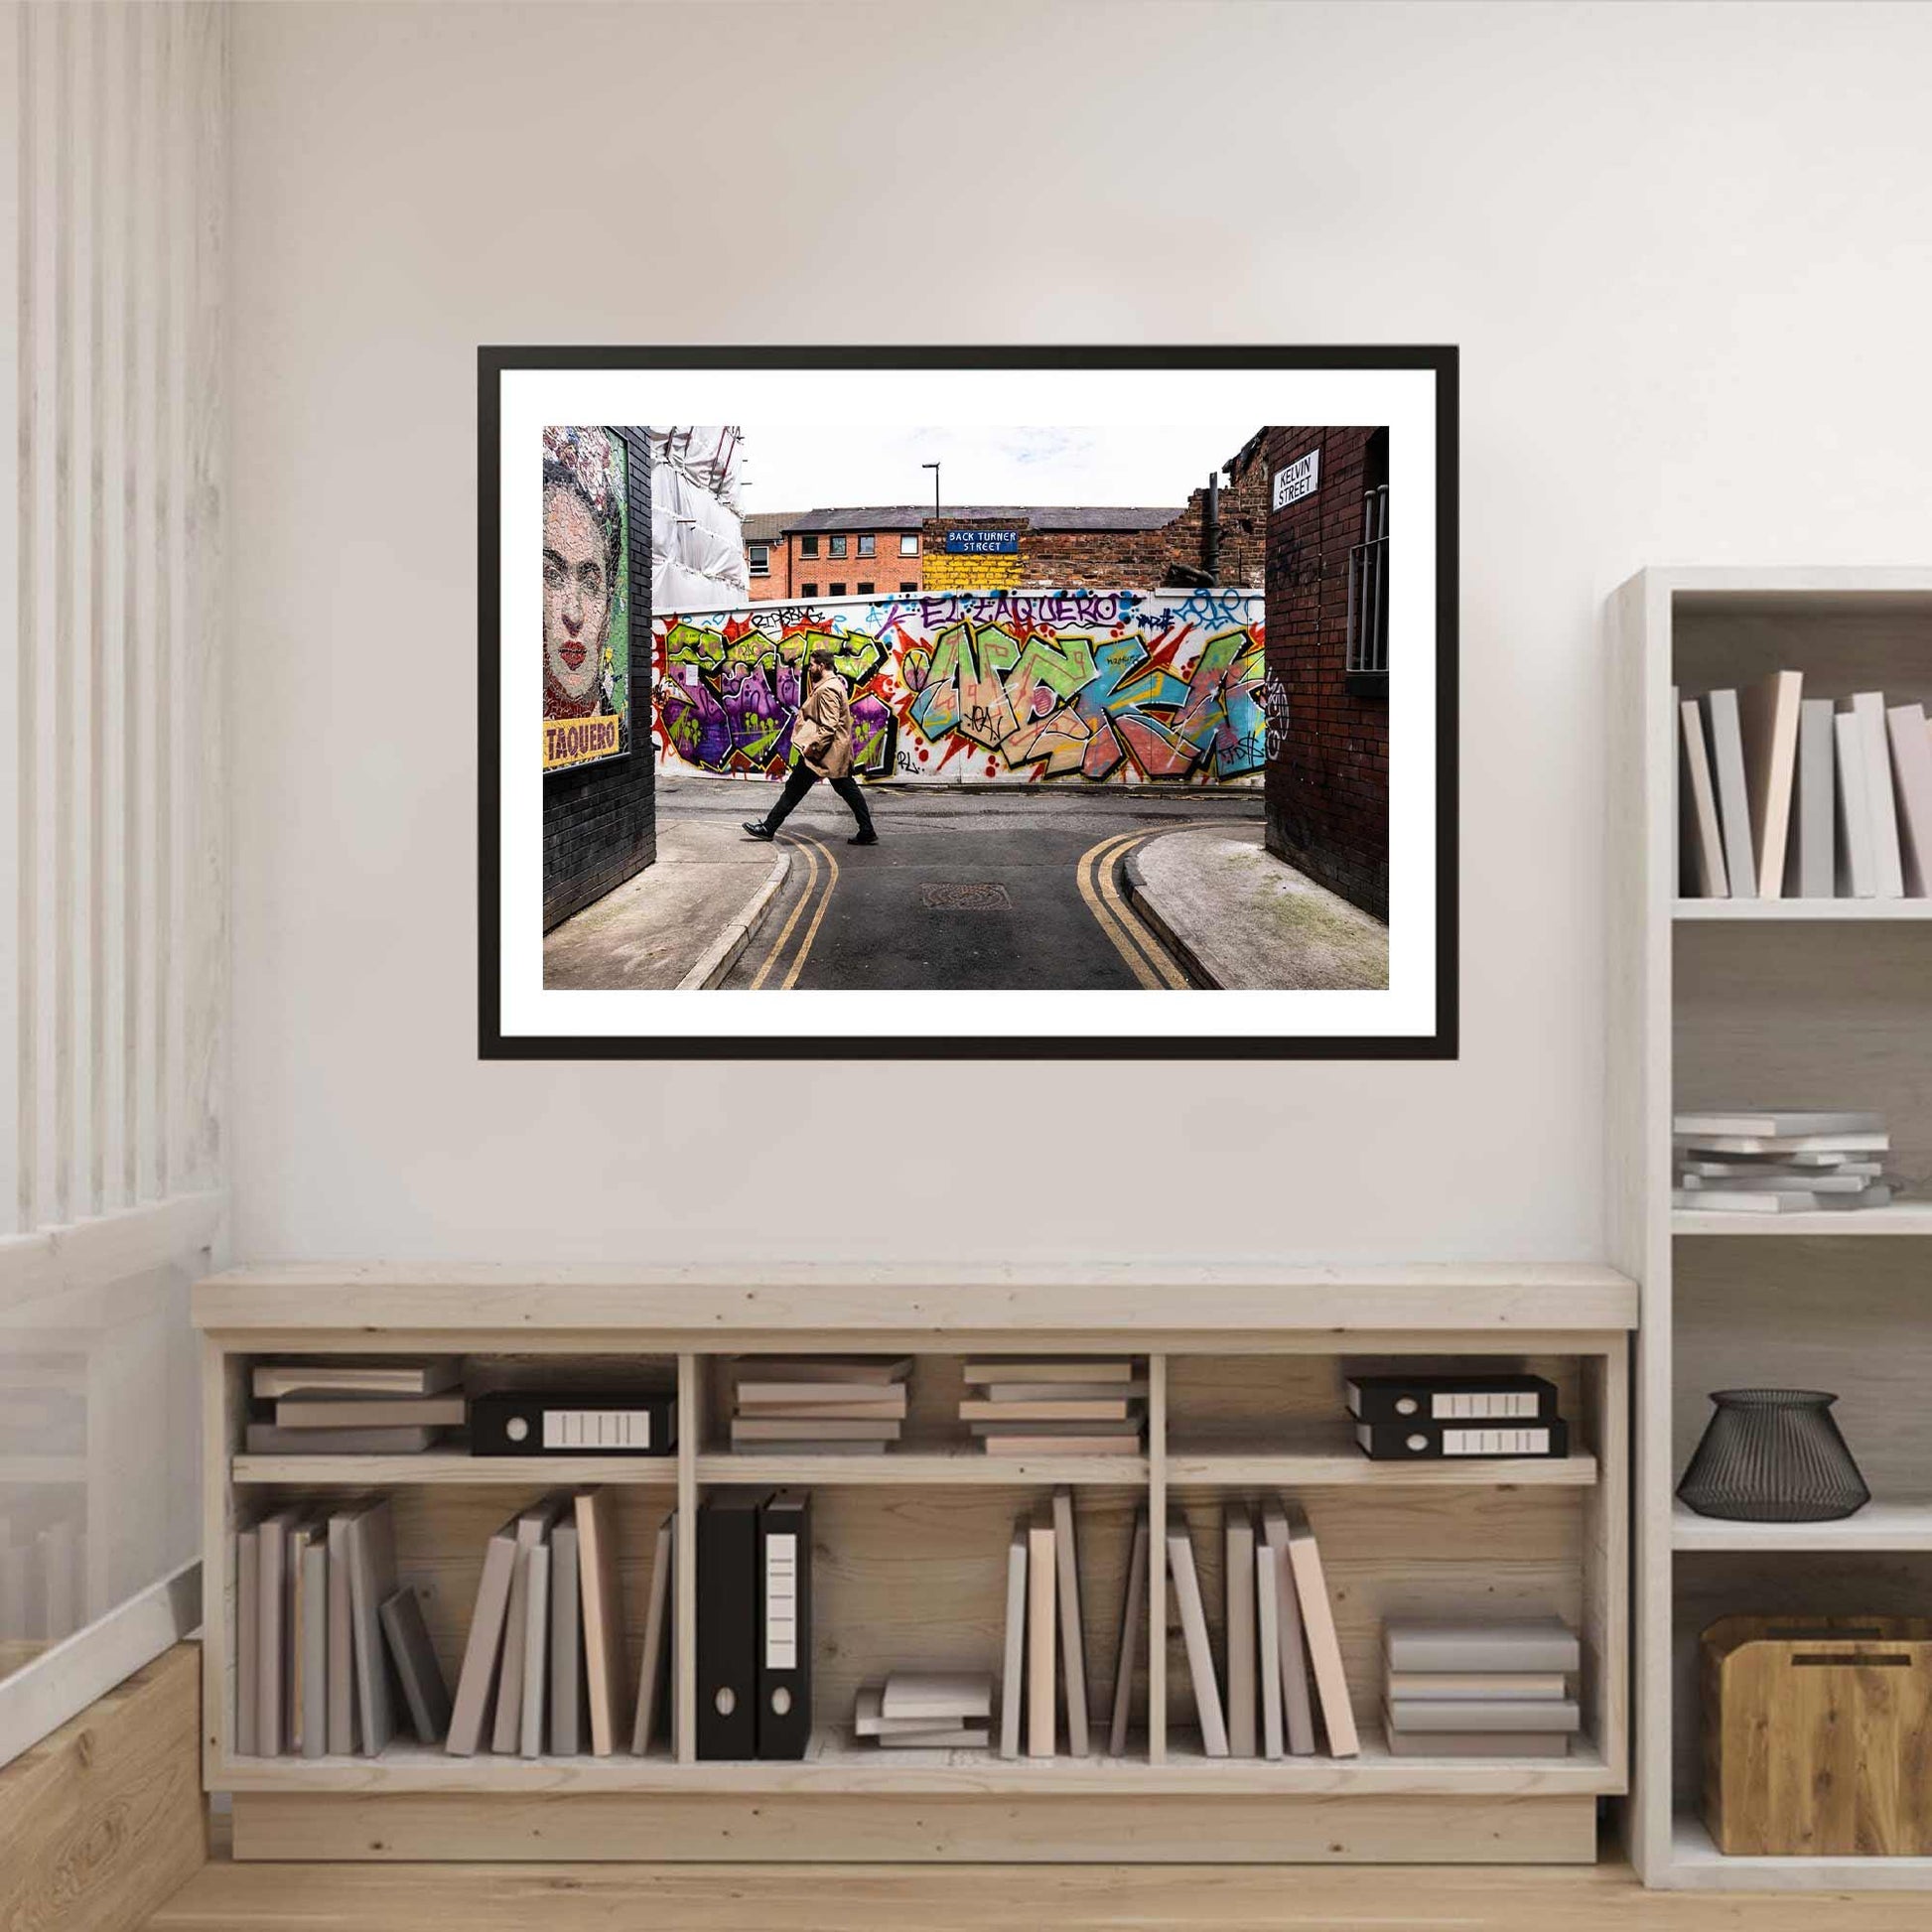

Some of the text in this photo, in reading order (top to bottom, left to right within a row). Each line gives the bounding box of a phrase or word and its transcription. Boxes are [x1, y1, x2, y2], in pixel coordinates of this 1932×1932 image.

[1280, 457, 1311, 488] KELVIN
[1278, 475, 1311, 505] STREET
[949, 532, 1017, 542] BACK TURNER
[963, 542, 1001, 552] STREET
[546, 721, 616, 761] TAQUERO
